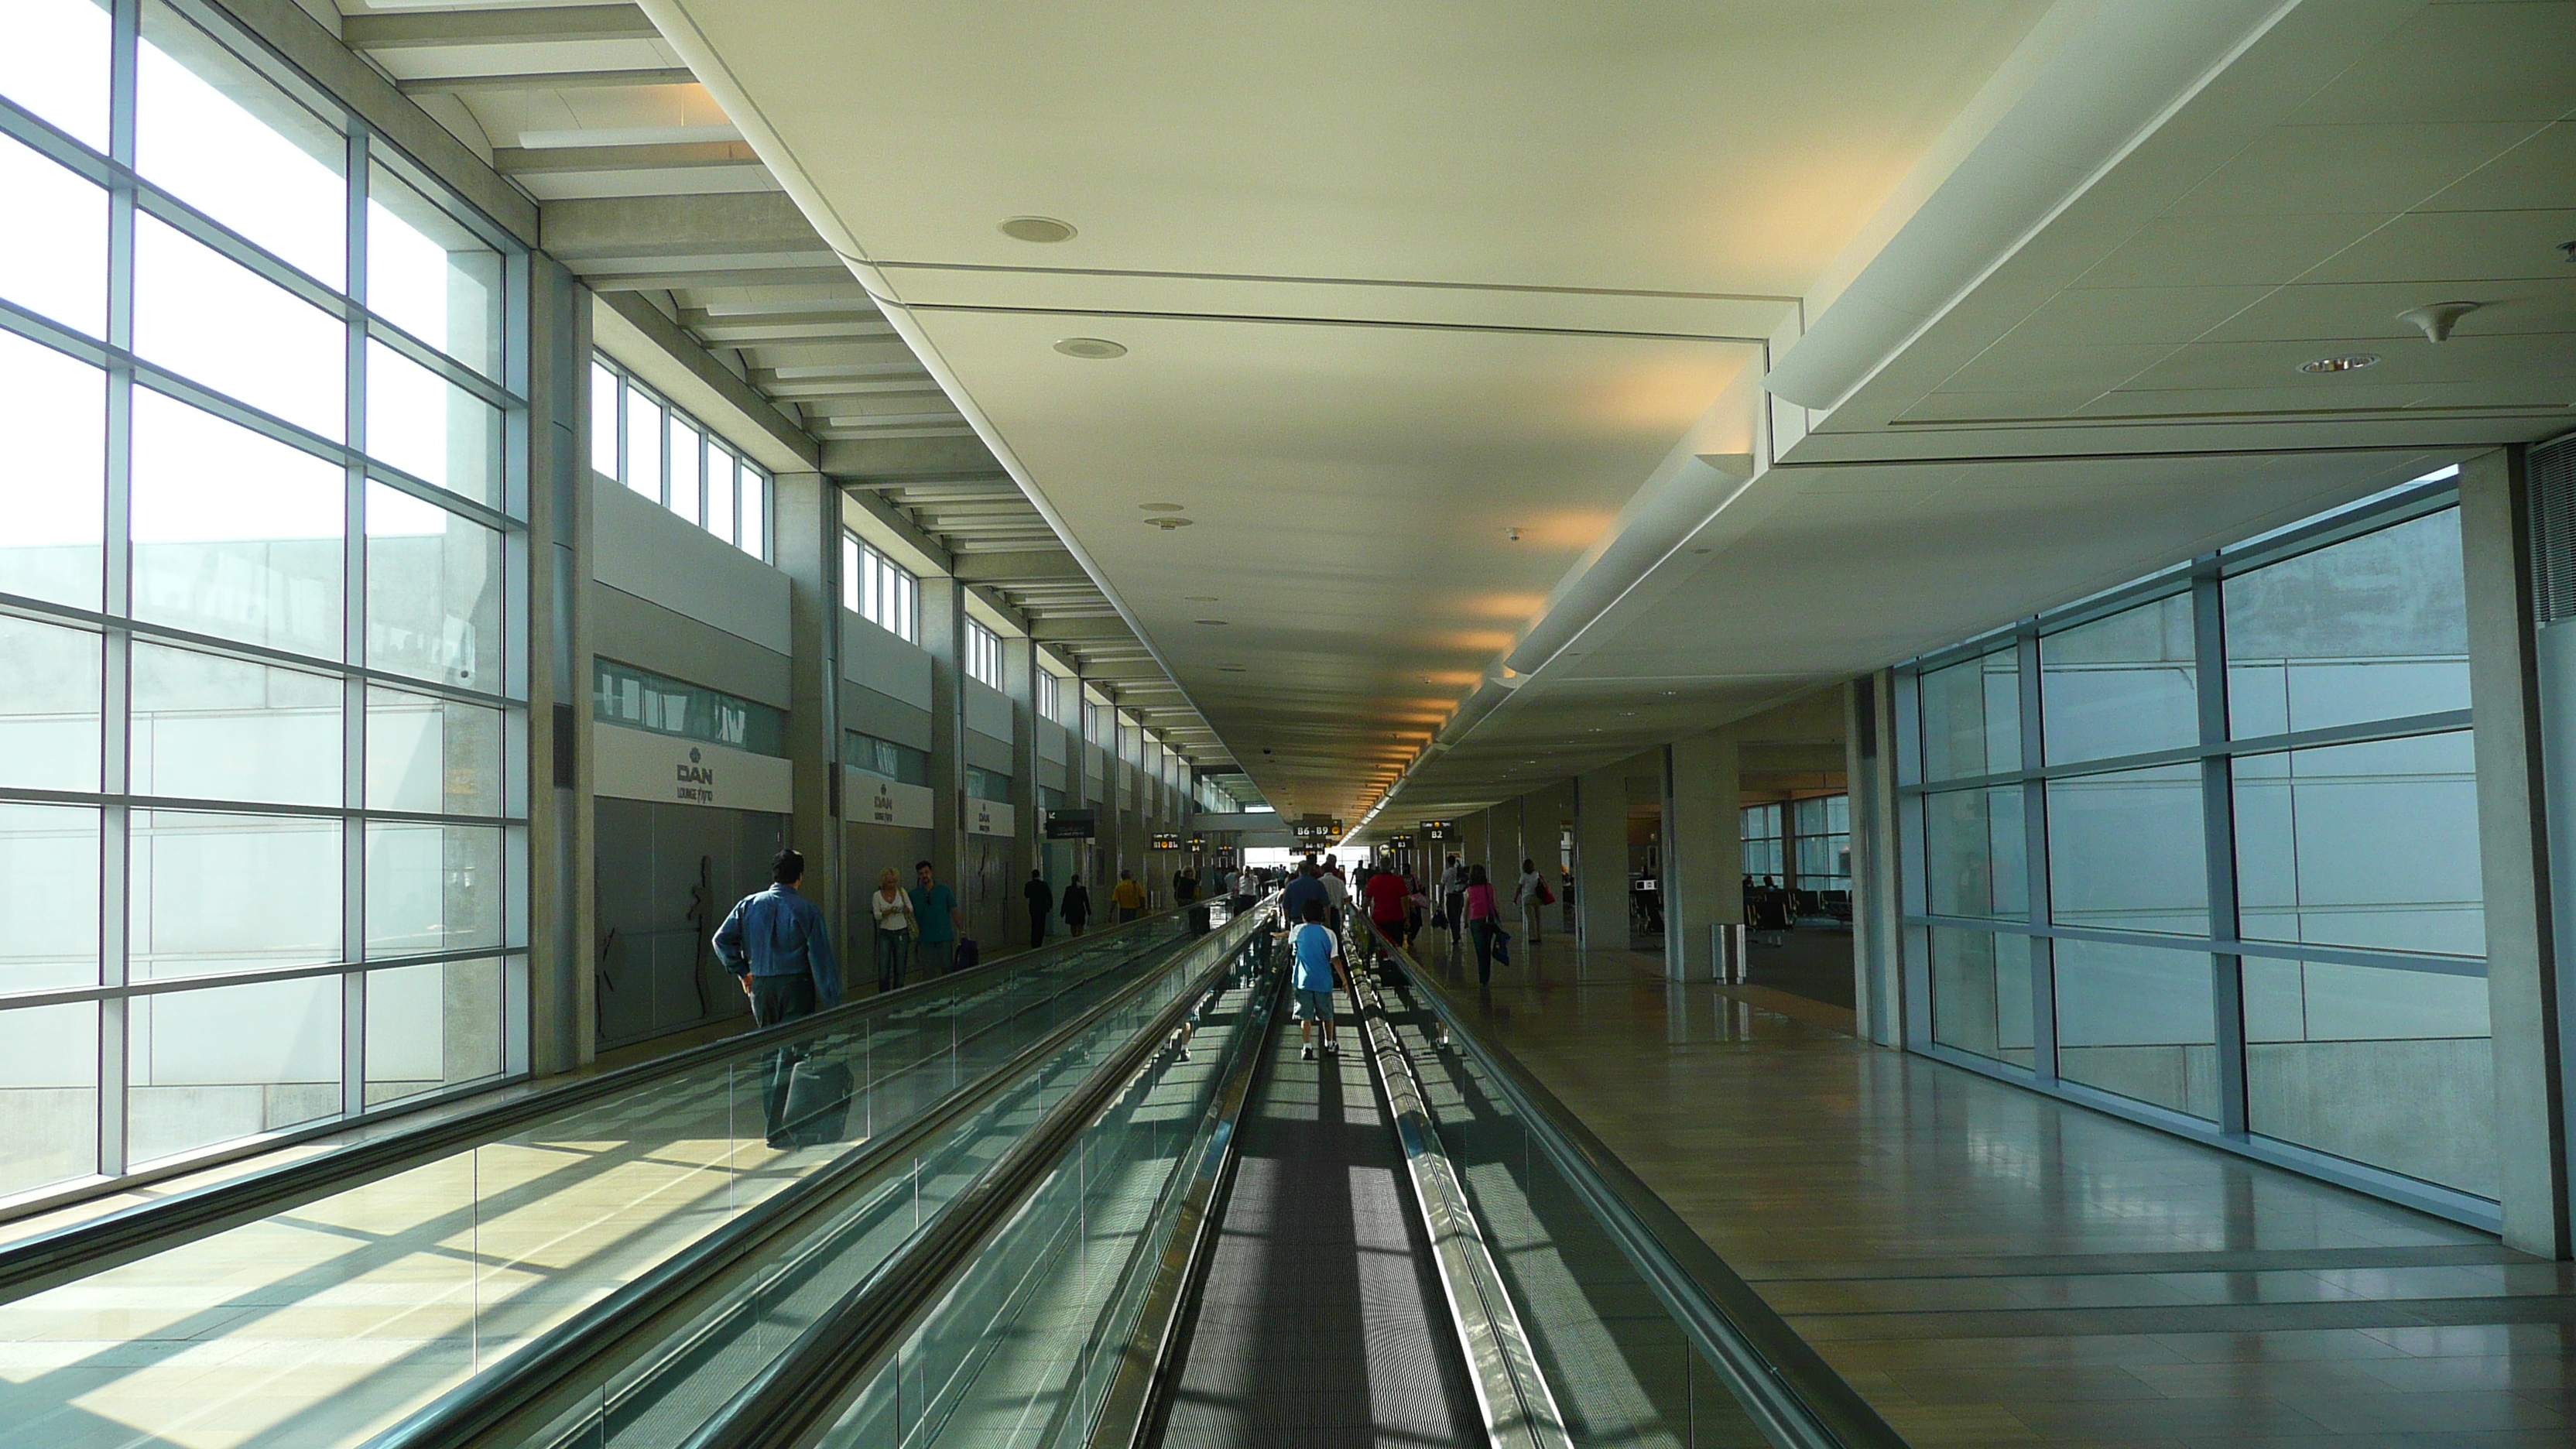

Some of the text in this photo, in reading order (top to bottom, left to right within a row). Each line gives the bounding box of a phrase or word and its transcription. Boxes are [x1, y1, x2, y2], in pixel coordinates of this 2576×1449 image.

[677, 764, 713, 785] DAN
[677, 786, 697, 800] LOUNGE
[874, 796, 892, 810] DAN
[979, 813, 990, 823] DAN
[1431, 831, 1443, 839] B2
